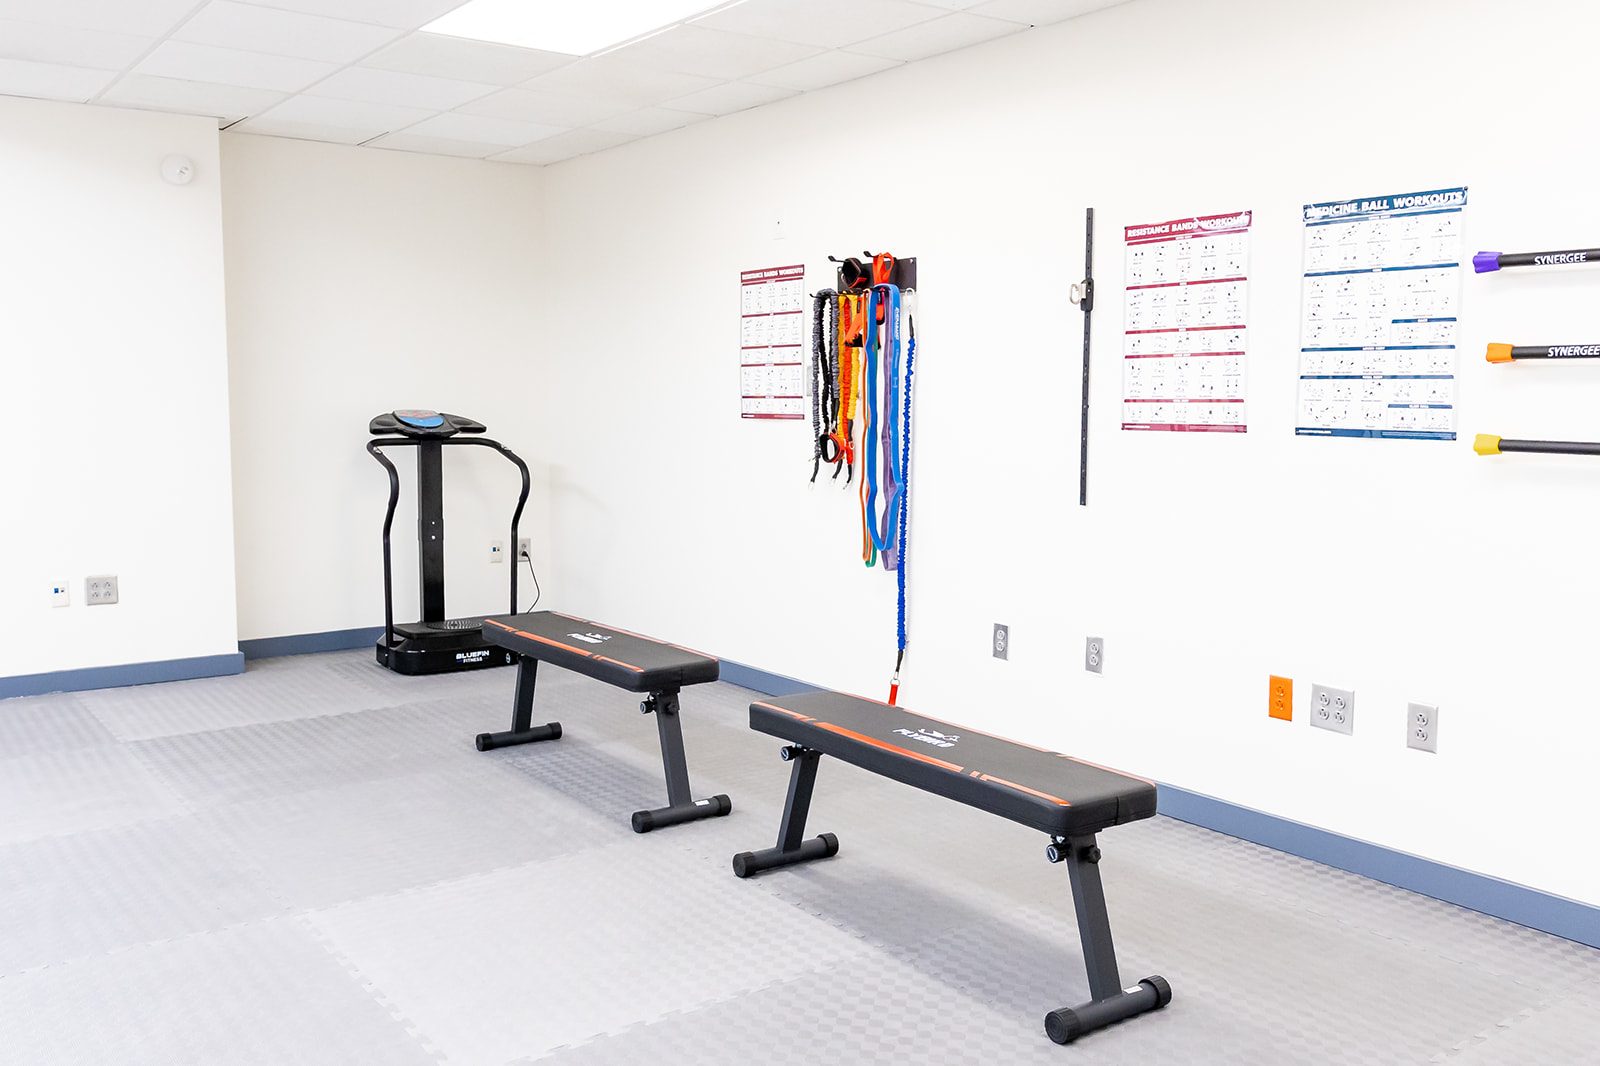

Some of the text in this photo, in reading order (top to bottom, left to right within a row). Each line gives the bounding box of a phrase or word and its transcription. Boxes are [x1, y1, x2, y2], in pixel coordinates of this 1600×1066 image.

[1306, 192, 1463, 218] MEDICINE BALL WORKOUTS
[1127, 225, 1170, 238] RESISTANCE
[1172, 220, 1199, 232] BANDS
[1534, 252, 1587, 265] SYNERGEE
[1547, 346, 1600, 357] SYNERGEE
[456, 650, 489, 659] BLUEFIN
